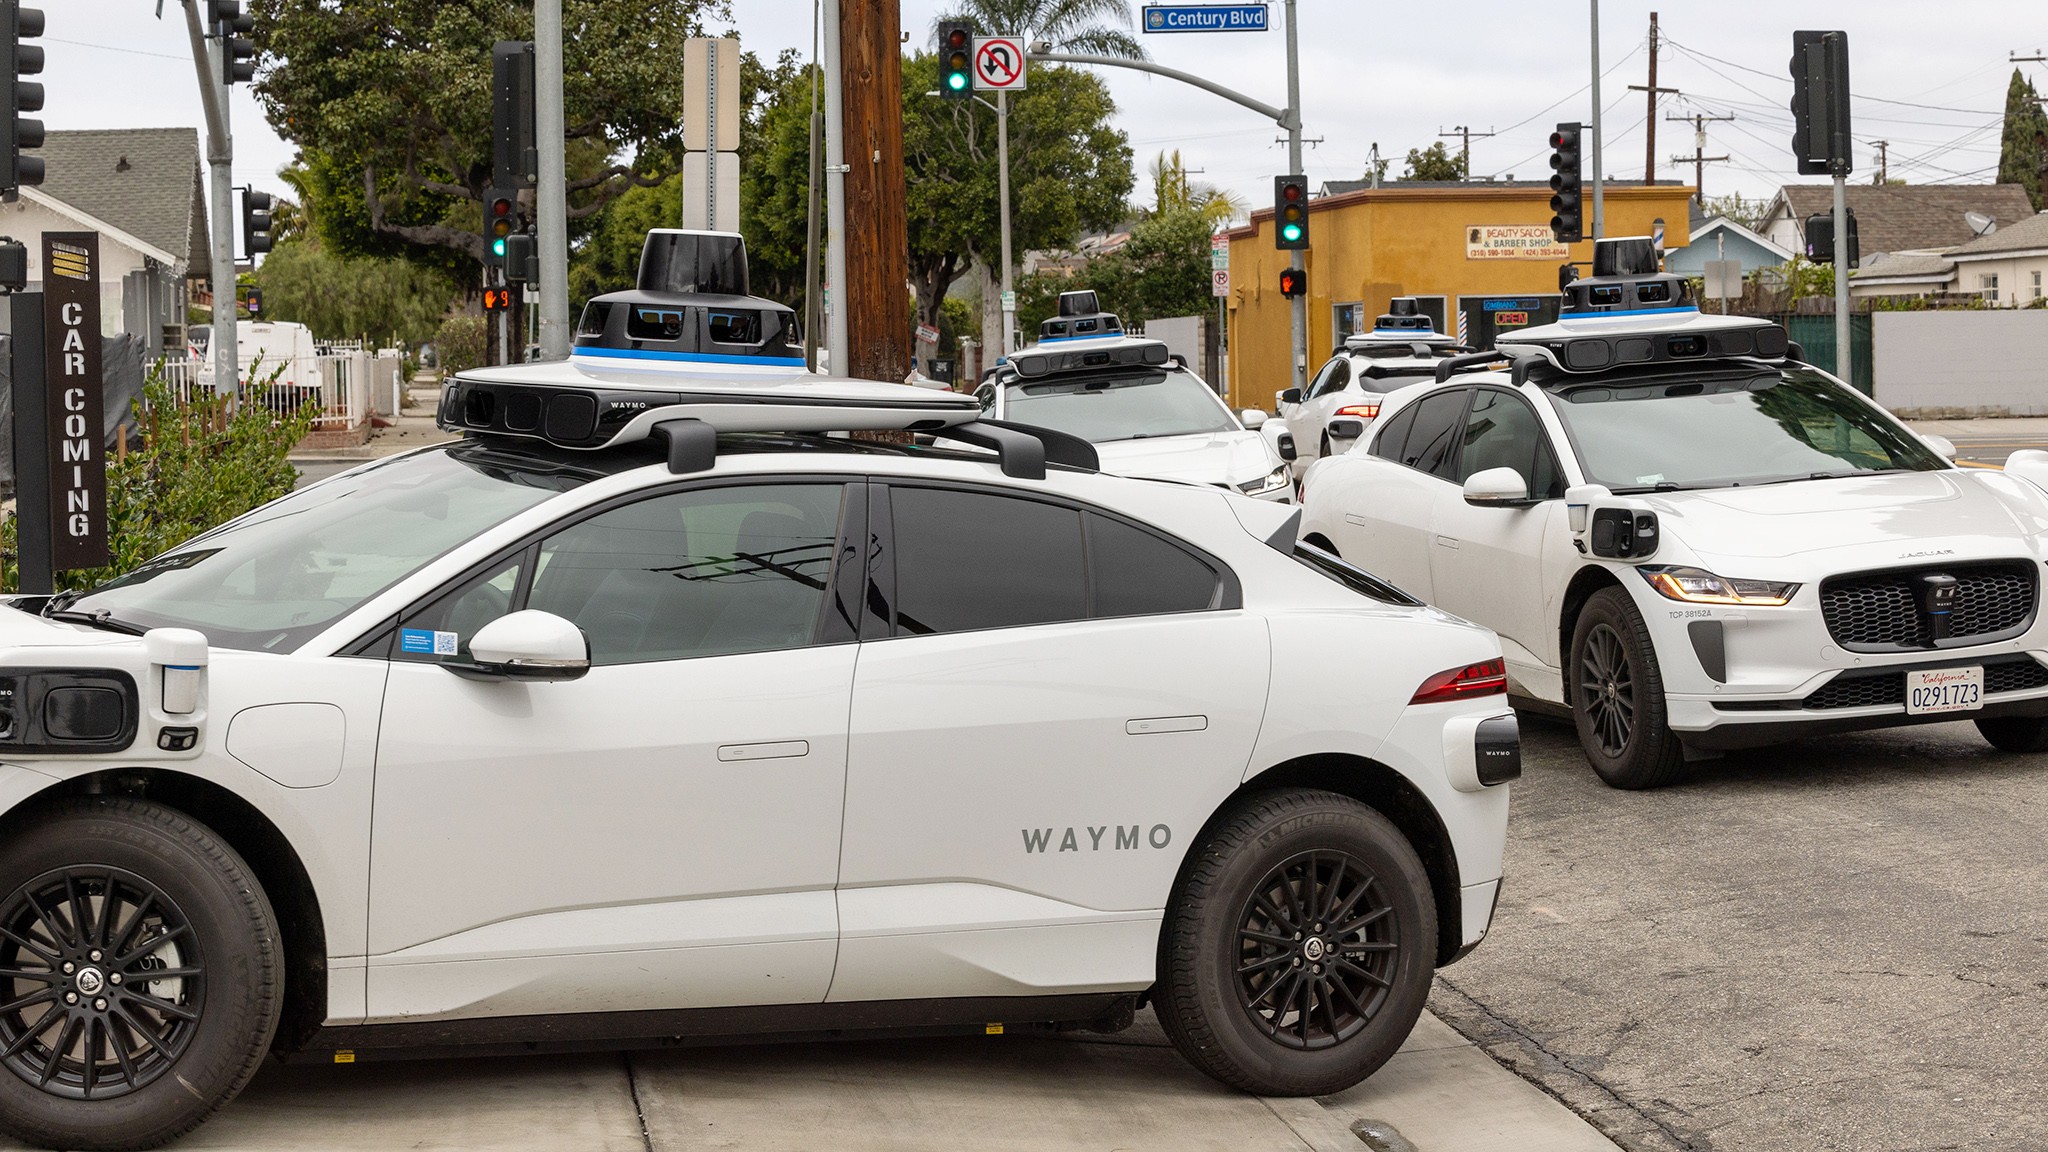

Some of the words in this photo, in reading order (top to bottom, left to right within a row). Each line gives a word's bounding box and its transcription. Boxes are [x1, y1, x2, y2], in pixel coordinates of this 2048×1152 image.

[1167, 11, 1228, 28] Century
[1230, 10, 1264, 25] Blvd
[1487, 228, 1519, 238] BEAUTY
[1520, 228, 1548, 238] SALON
[1493, 239, 1527, 248] BARBER
[1529, 239, 1552, 247] SHOP
[1522, 249, 1539, 257] (424)
[500, 290, 509, 307] 9
[1496, 313, 1527, 324] OPEN
[61, 302, 86, 376] CAR
[610, 401, 646, 409] WAYMO
[62, 388, 91, 537] COMING
[1669, 611, 1684, 619] TCP
[1684, 609, 1712, 618] 38152A
[1922, 672, 1967, 685] California
[1912, 683, 1979, 708] 02917Z3
[1021, 823, 1172, 854] WAYMO
